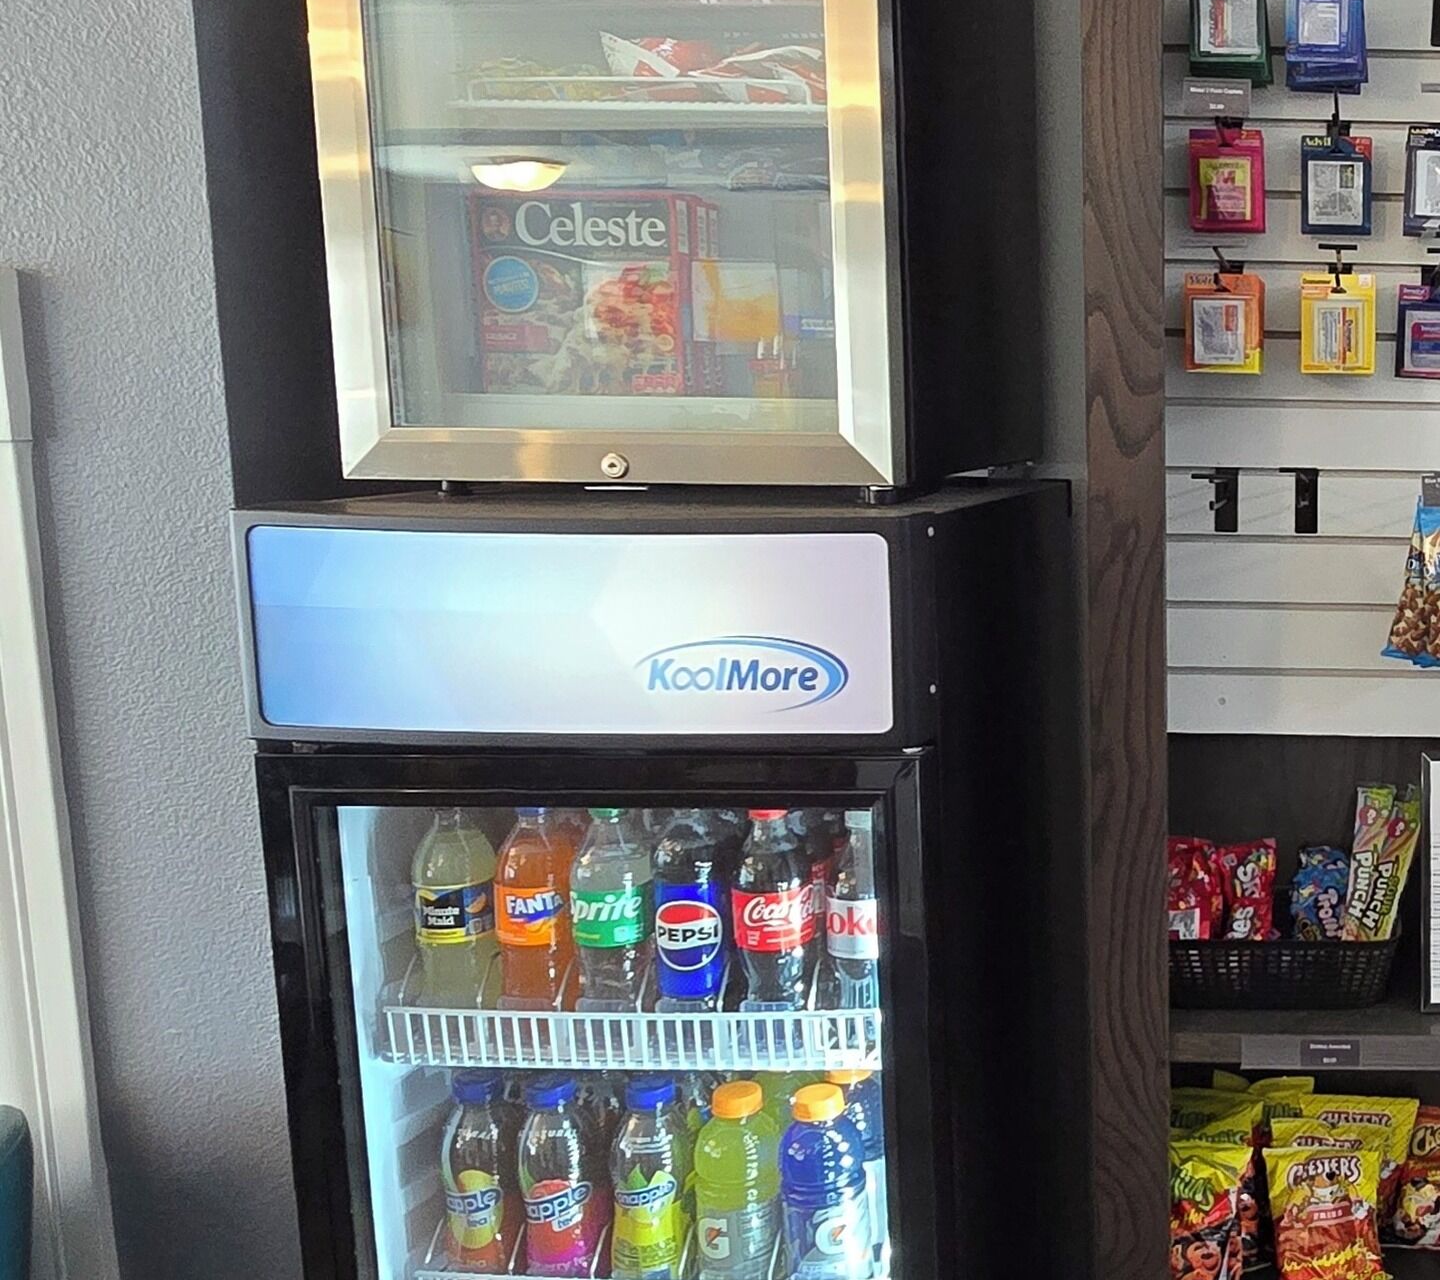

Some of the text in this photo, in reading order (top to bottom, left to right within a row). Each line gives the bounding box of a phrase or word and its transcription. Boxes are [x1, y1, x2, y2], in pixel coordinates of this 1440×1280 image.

[1304, 136, 1331, 147] Advil
[515, 200, 666, 247] Celeste
[647, 658, 819, 691] KoolMore
[1347, 851, 1374, 919] PUNCH
[1361, 861, 1393, 930] PUNCH
[423, 905, 460, 916] Minute
[506, 891, 564, 916] FANTA
[571, 891, 642, 923] Sprite
[427, 915, 455, 926] Maid
[658, 925, 718, 942] PEPSI
[699, 1218, 730, 1259] G
